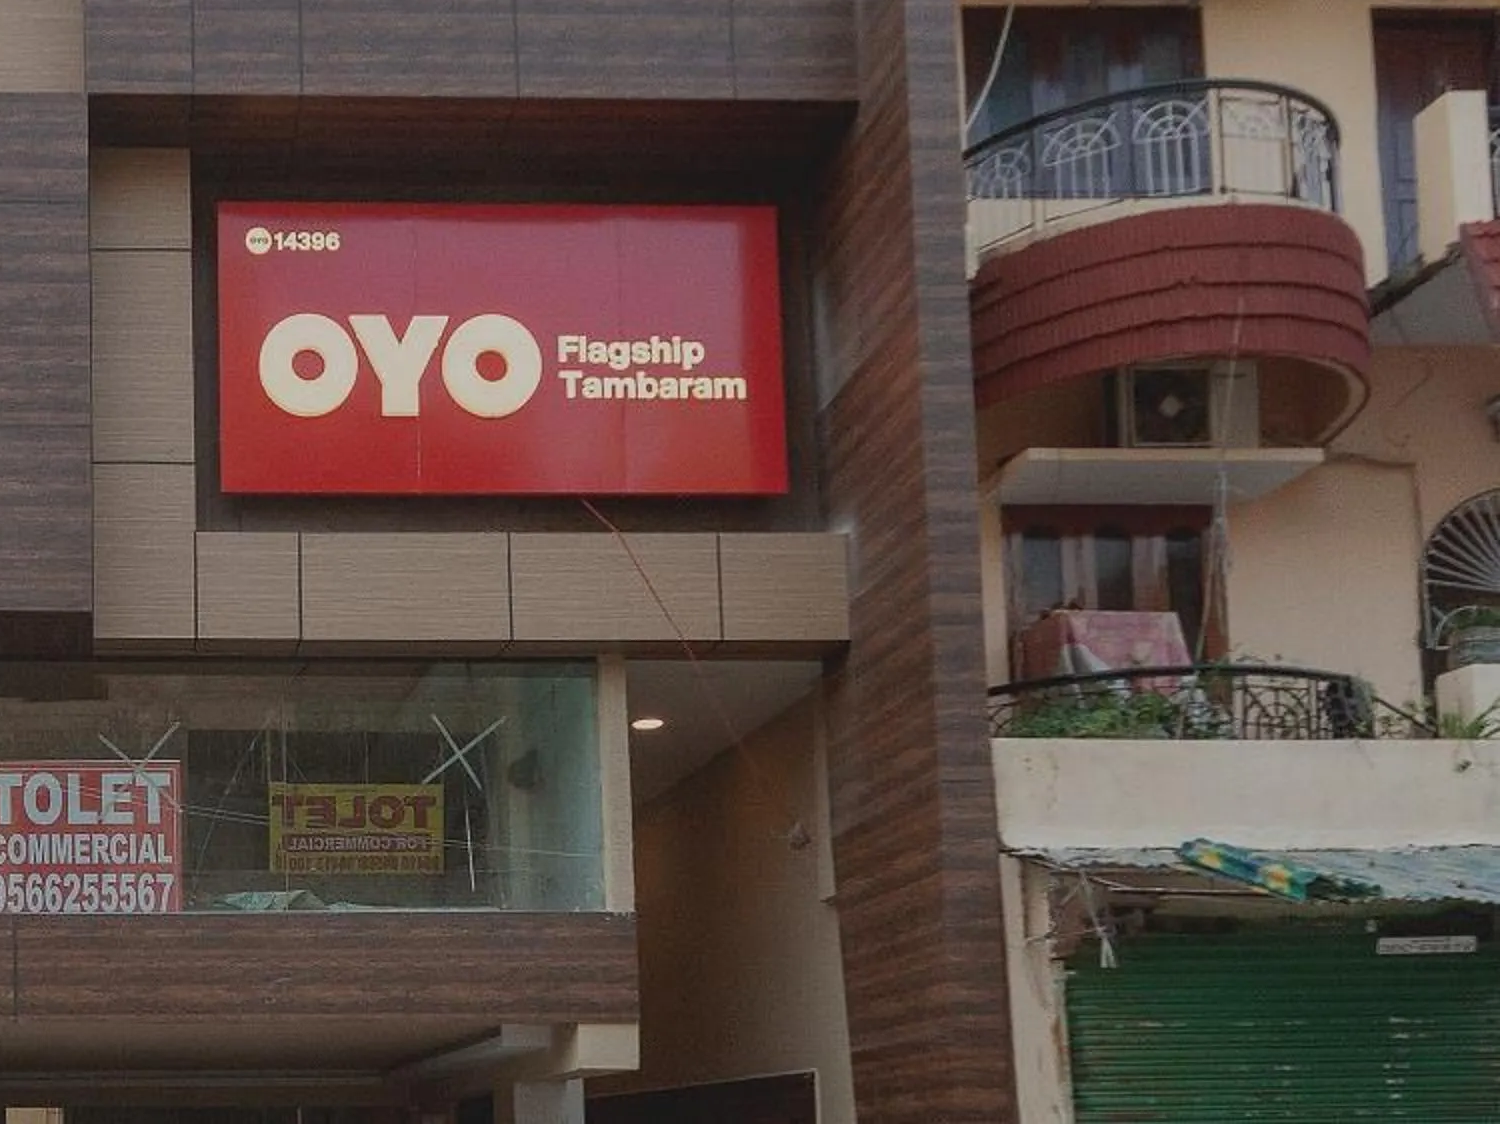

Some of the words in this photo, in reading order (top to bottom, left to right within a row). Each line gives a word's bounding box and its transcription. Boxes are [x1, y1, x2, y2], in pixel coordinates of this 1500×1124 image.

[273, 231, 341, 251] 14396
[259, 313, 542, 417] OYO
[557, 335, 705, 369] Flagship
[558, 370, 747, 399] Tambaram
